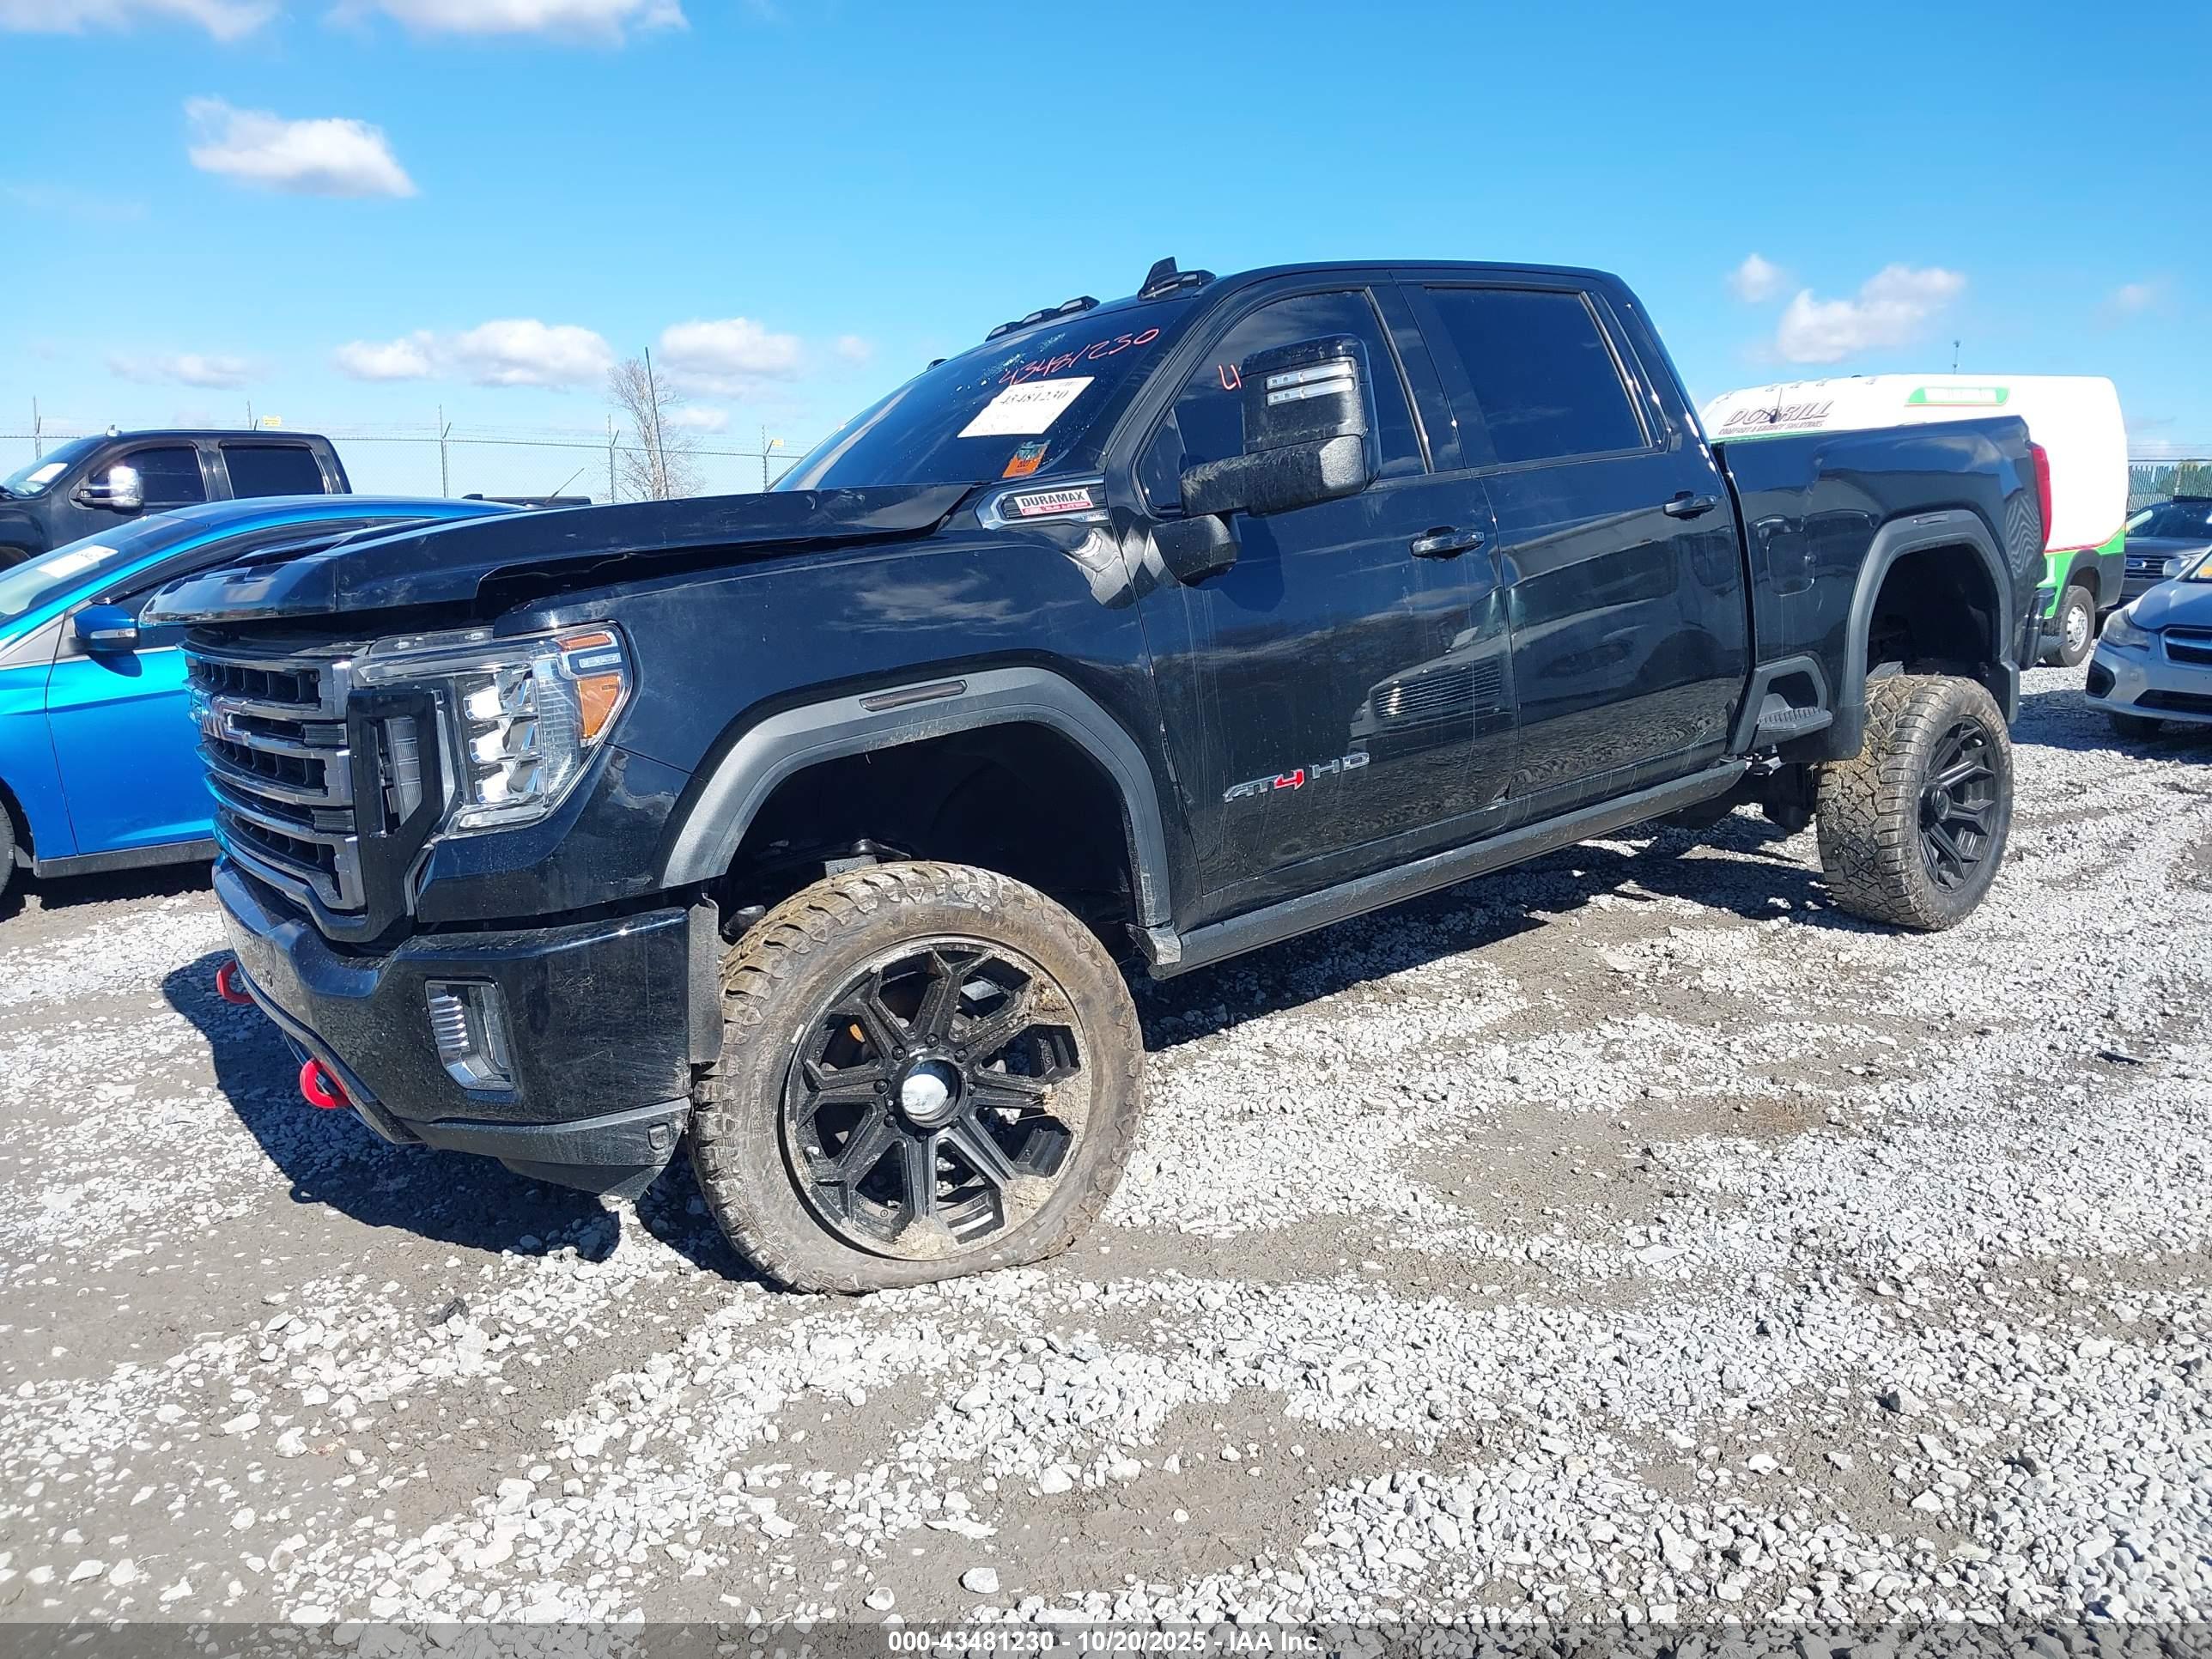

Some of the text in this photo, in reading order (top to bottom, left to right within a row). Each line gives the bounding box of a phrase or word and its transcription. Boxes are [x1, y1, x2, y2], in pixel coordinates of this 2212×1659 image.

[998, 328, 1159, 386] 43481230
[1020, 491, 1085, 507] DURAMAX
[1223, 752, 1370, 803] AT4 HD
